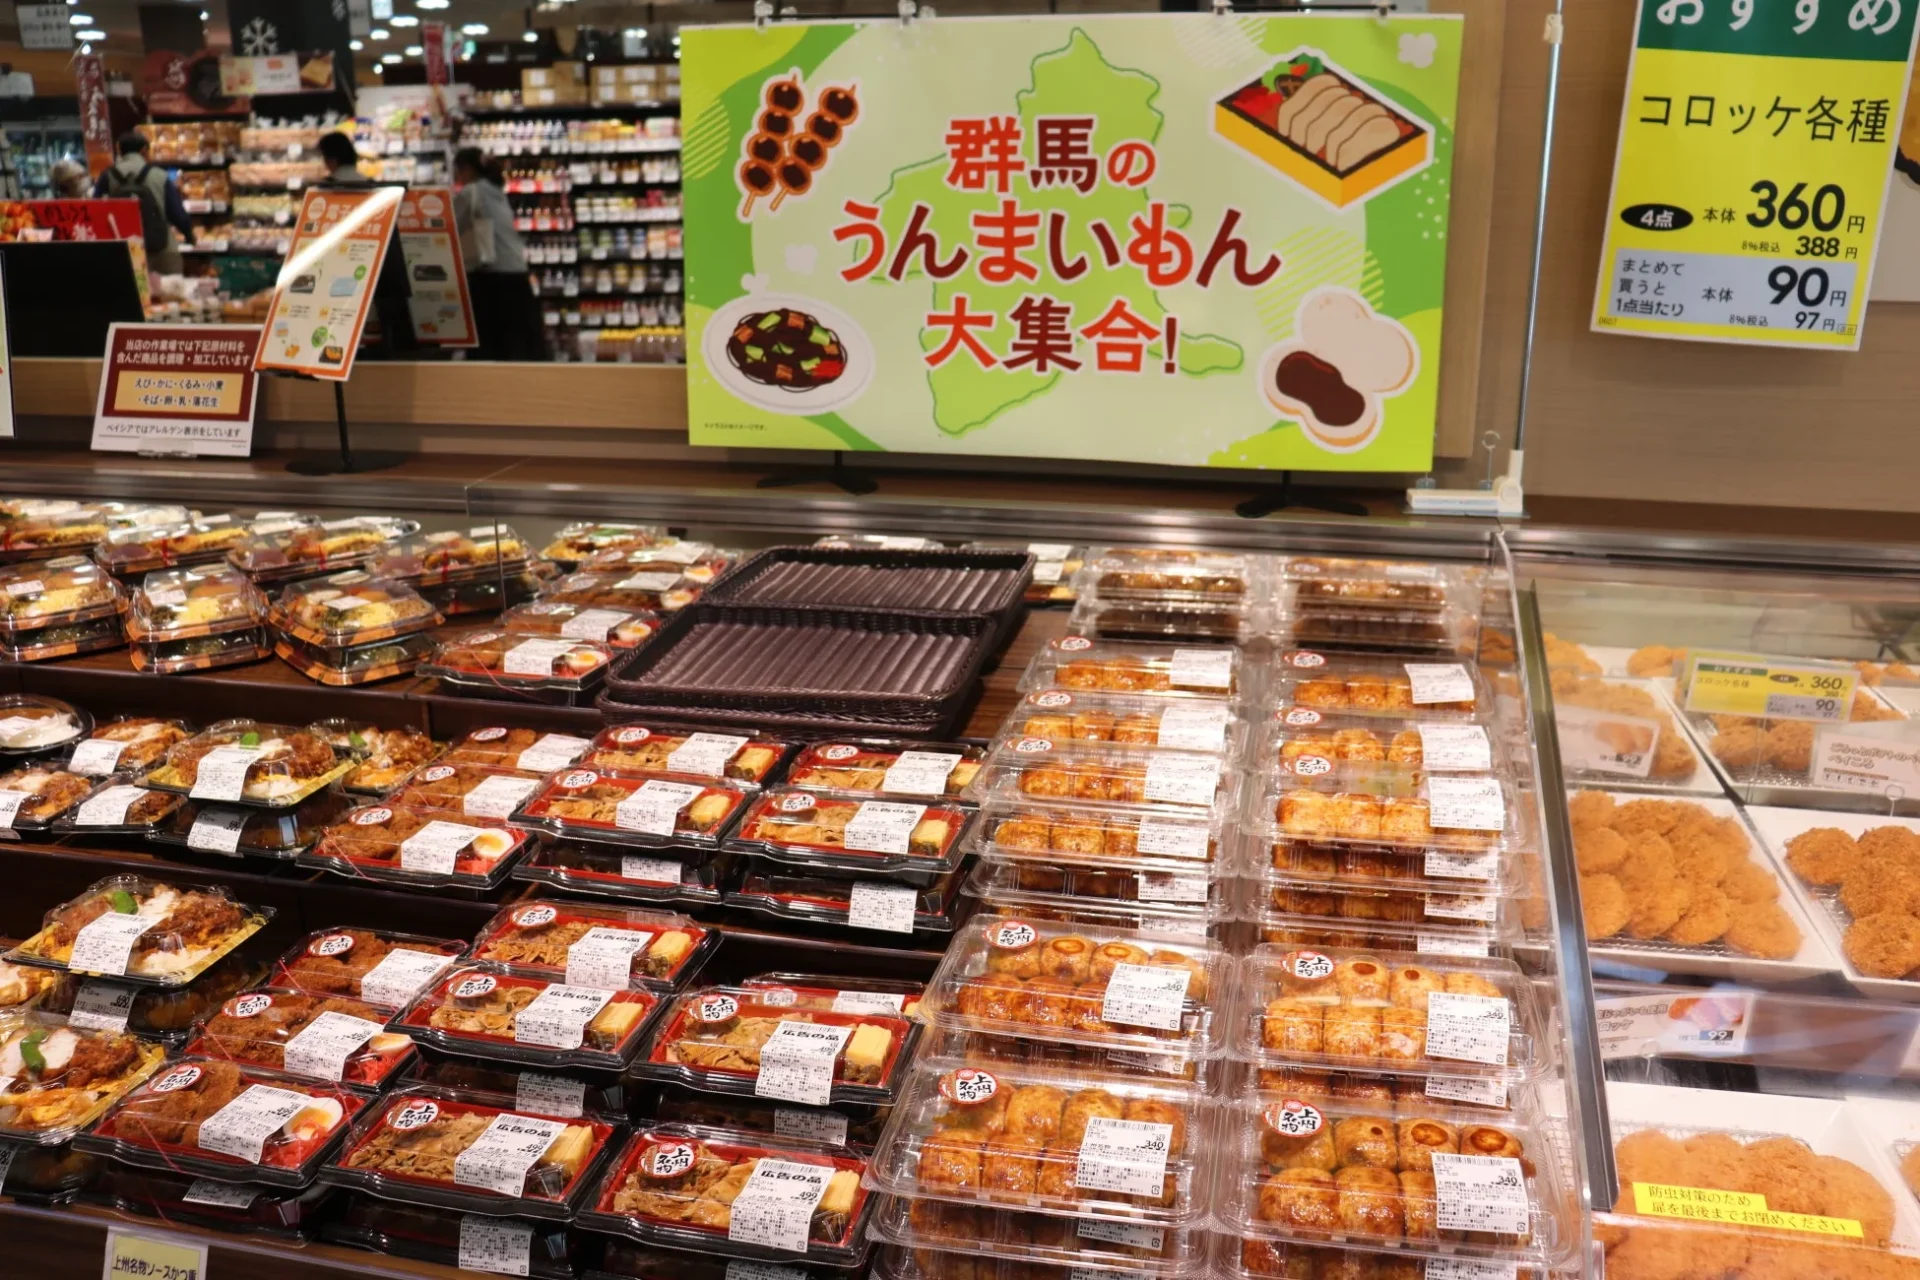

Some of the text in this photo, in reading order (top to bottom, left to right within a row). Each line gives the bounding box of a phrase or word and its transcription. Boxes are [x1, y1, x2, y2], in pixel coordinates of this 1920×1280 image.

[1639, 95, 1890, 144] コロッケ各種
[945, 115, 1157, 194] 群馬の
[1640, 210, 1675, 228] 4点
[1702, 207, 1737, 224] 本体
[832, 200, 1282, 287] うんまいもん
[1741, 240, 1780, 253] 8%税込
[1622, 258, 1686, 277] まとめて
[1619, 278, 1667, 296] 買うと
[1701, 287, 1734, 302] 本体
[1616, 297, 1685, 317] 1点当たり
[1729, 314, 1768, 327] 8%税込
[125, 339, 246, 353] 当店の作業場では下記原材料を
[116, 352, 250, 367] 含んだ商品を調理・加工しています
[134, 377, 224, 390] えび・かに・くるみ・小麦
[106, 424, 241, 437] ベイシアではアレルゲン表示をしています
[782, 1029, 840, 1041] 広告の品
[973, 1073, 992, 1094] 上州
[1299, 1108, 1318, 1130] 上州
[496, 1124, 552, 1137] 広告の品
[672, 1148, 691, 1167] 上州
[761, 1170, 822, 1184] 広告の品
[1648, 1184, 1752, 1208] 防虫対策のため
[1651, 1201, 1847, 1233] 扉を最後までお閉めください
[112, 1254, 197, 1280] 上州名物ソースかつ重
